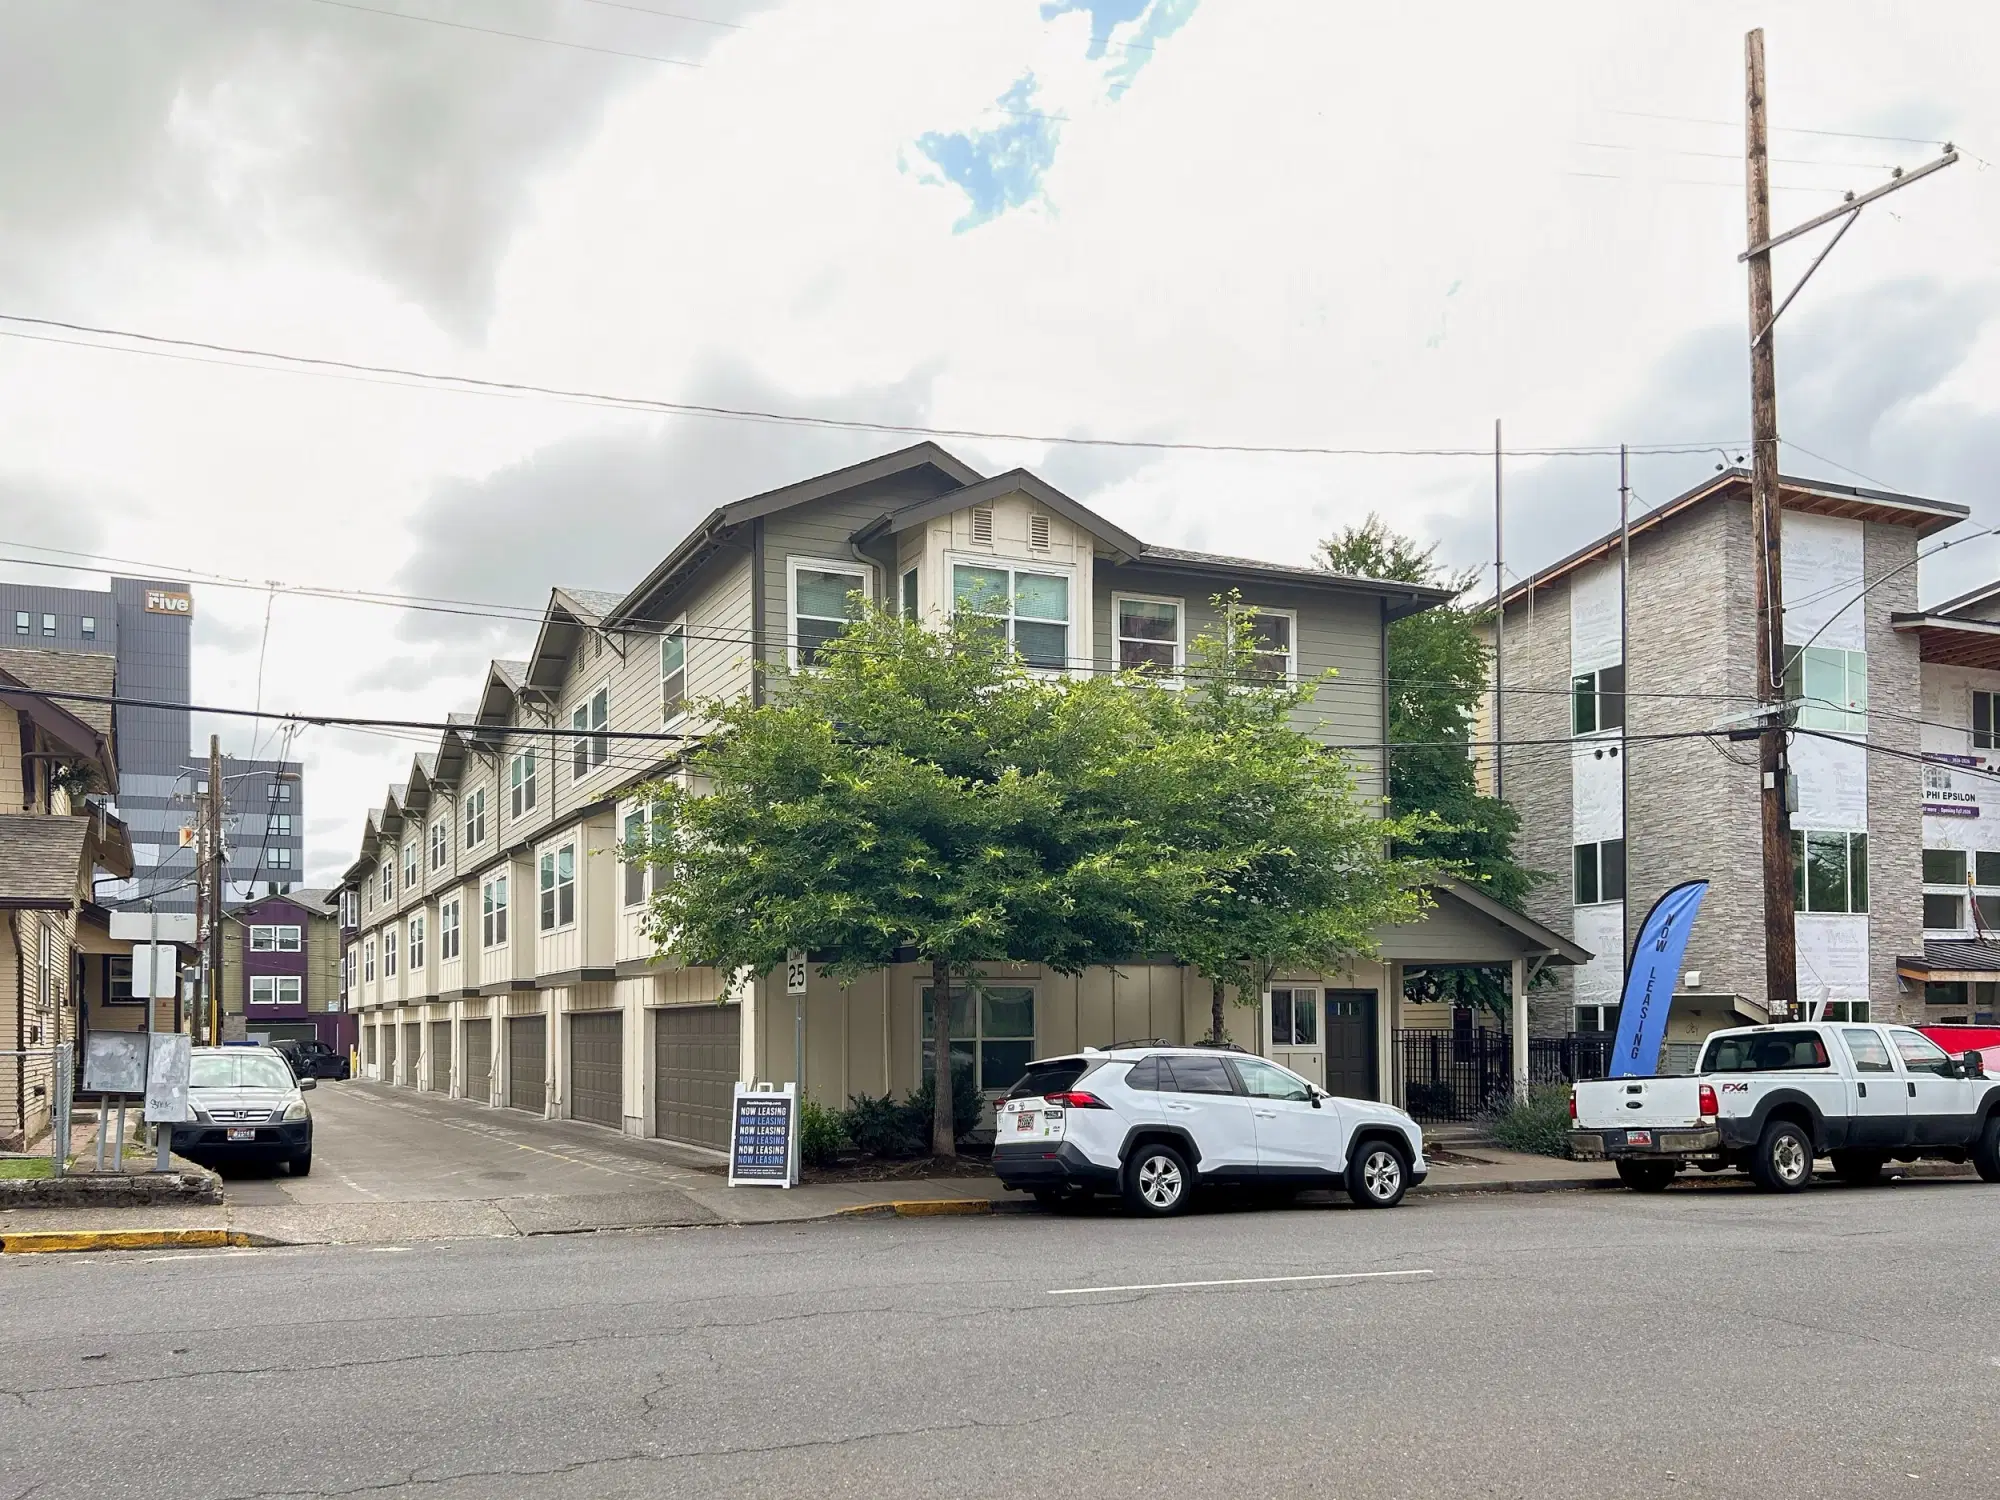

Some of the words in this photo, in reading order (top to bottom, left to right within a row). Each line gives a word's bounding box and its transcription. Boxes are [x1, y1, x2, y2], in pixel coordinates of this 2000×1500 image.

[148, 593, 189, 611] rive
[1926, 790, 1940, 799] PHI
[1943, 792, 1976, 802] EPSILON
[1655, 914, 1675, 952] NOW
[789, 963, 805, 987] 25
[1631, 966, 1656, 1060] LEASING
[1722, 1083, 1748, 1092] FX4
[741, 1107, 756, 1116] NOW
[758, 1107, 787, 1116] LEASING
[740, 1117, 755, 1126] NOW
[757, 1117, 786, 1126] LEASING
[739, 1126, 755, 1135] NOW
[757, 1126, 785, 1135] LEASING
[739, 1136, 754, 1145] NOW
[756, 1136, 785, 1145] LEASING
[738, 1146, 754, 1155] NOW
[755, 1146, 785, 1155] LEASING
[737, 1155, 753, 1164] NOW
[755, 1155, 784, 1164] LEASING
